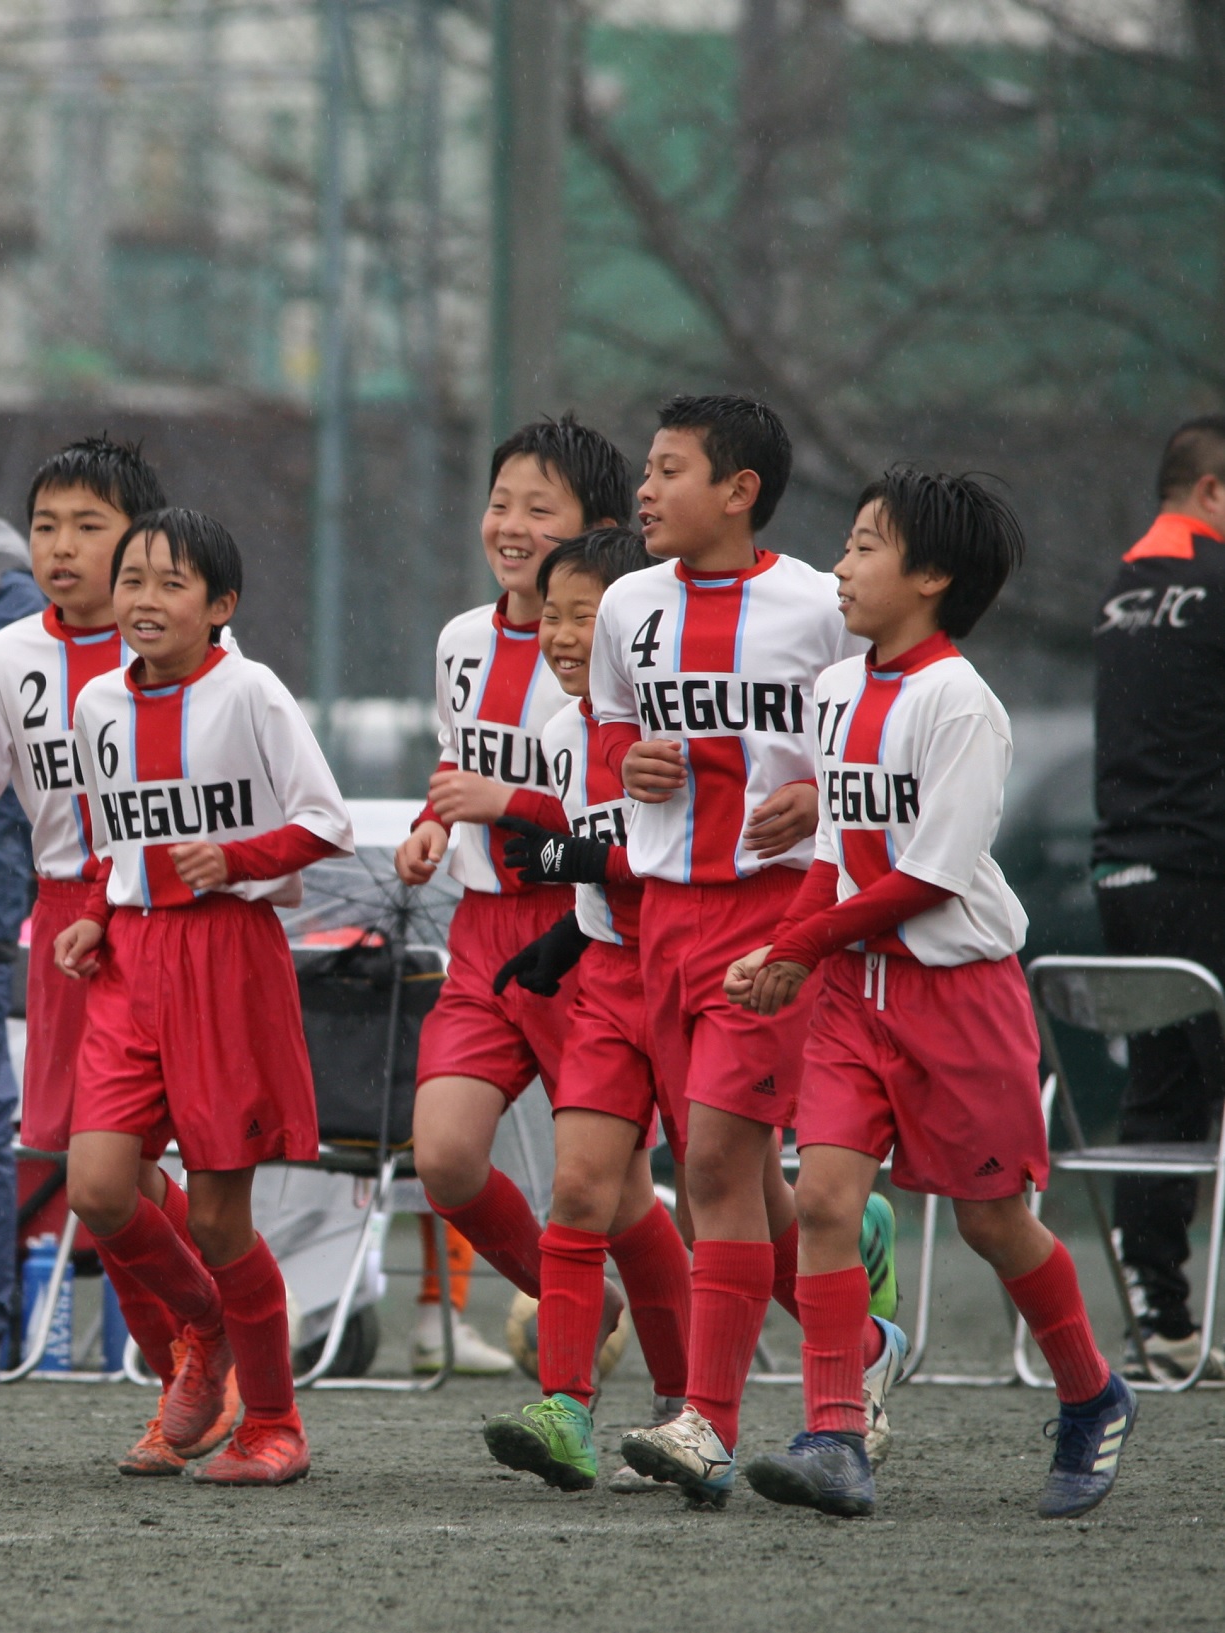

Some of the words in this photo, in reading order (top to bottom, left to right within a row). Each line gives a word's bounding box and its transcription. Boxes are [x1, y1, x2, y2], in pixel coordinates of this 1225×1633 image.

[631, 609, 664, 668] 4
[20, 670, 48, 730] 2
[634, 680, 804, 734] HEGURI
[97, 719, 119, 779] 6
[554, 748, 572, 803] 9
[100, 778, 254, 841] HEGURI
[554, 843, 565, 873] umbro
